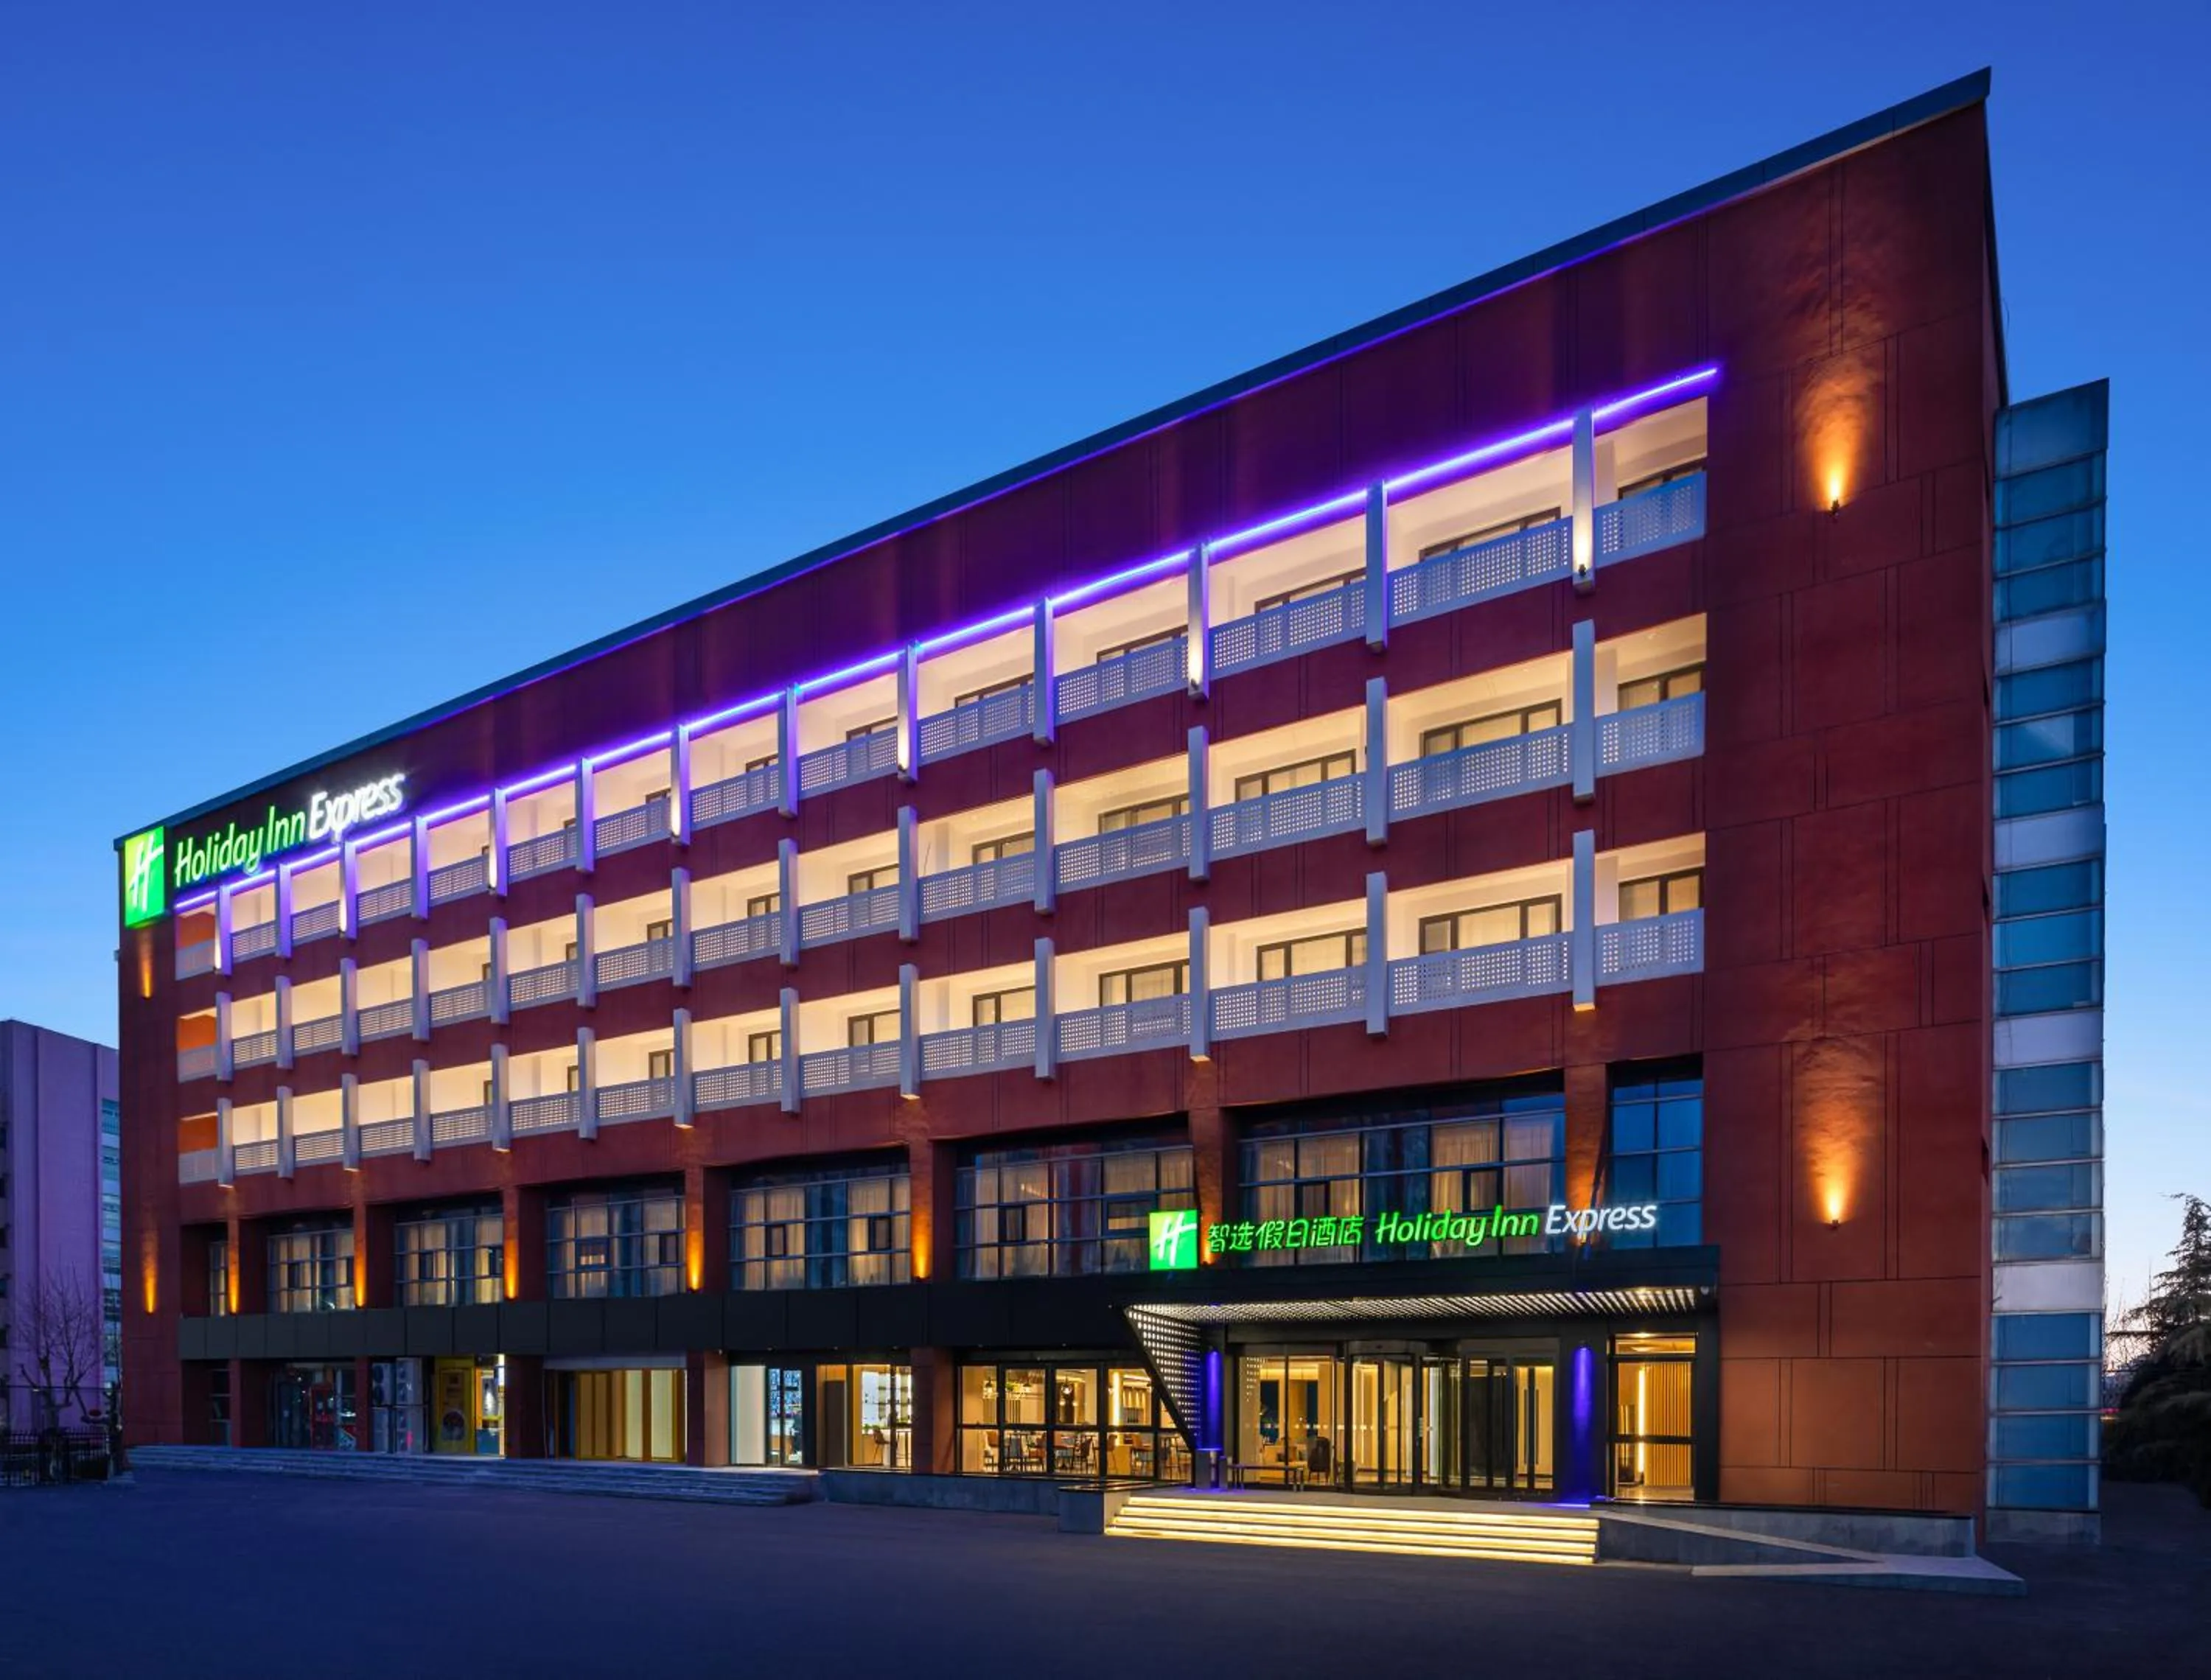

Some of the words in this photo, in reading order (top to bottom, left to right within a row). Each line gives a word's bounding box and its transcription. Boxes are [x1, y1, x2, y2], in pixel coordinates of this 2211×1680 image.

[174, 822, 264, 887] Holiday
[266, 805, 306, 853] Inn
[309, 773, 405, 842] Express
[1207, 1216, 1363, 1252] 智选假日酒店
[1375, 1208, 1487, 1245] Holiday
[1491, 1205, 1538, 1237] Inn
[1545, 1205, 1658, 1239] Express
